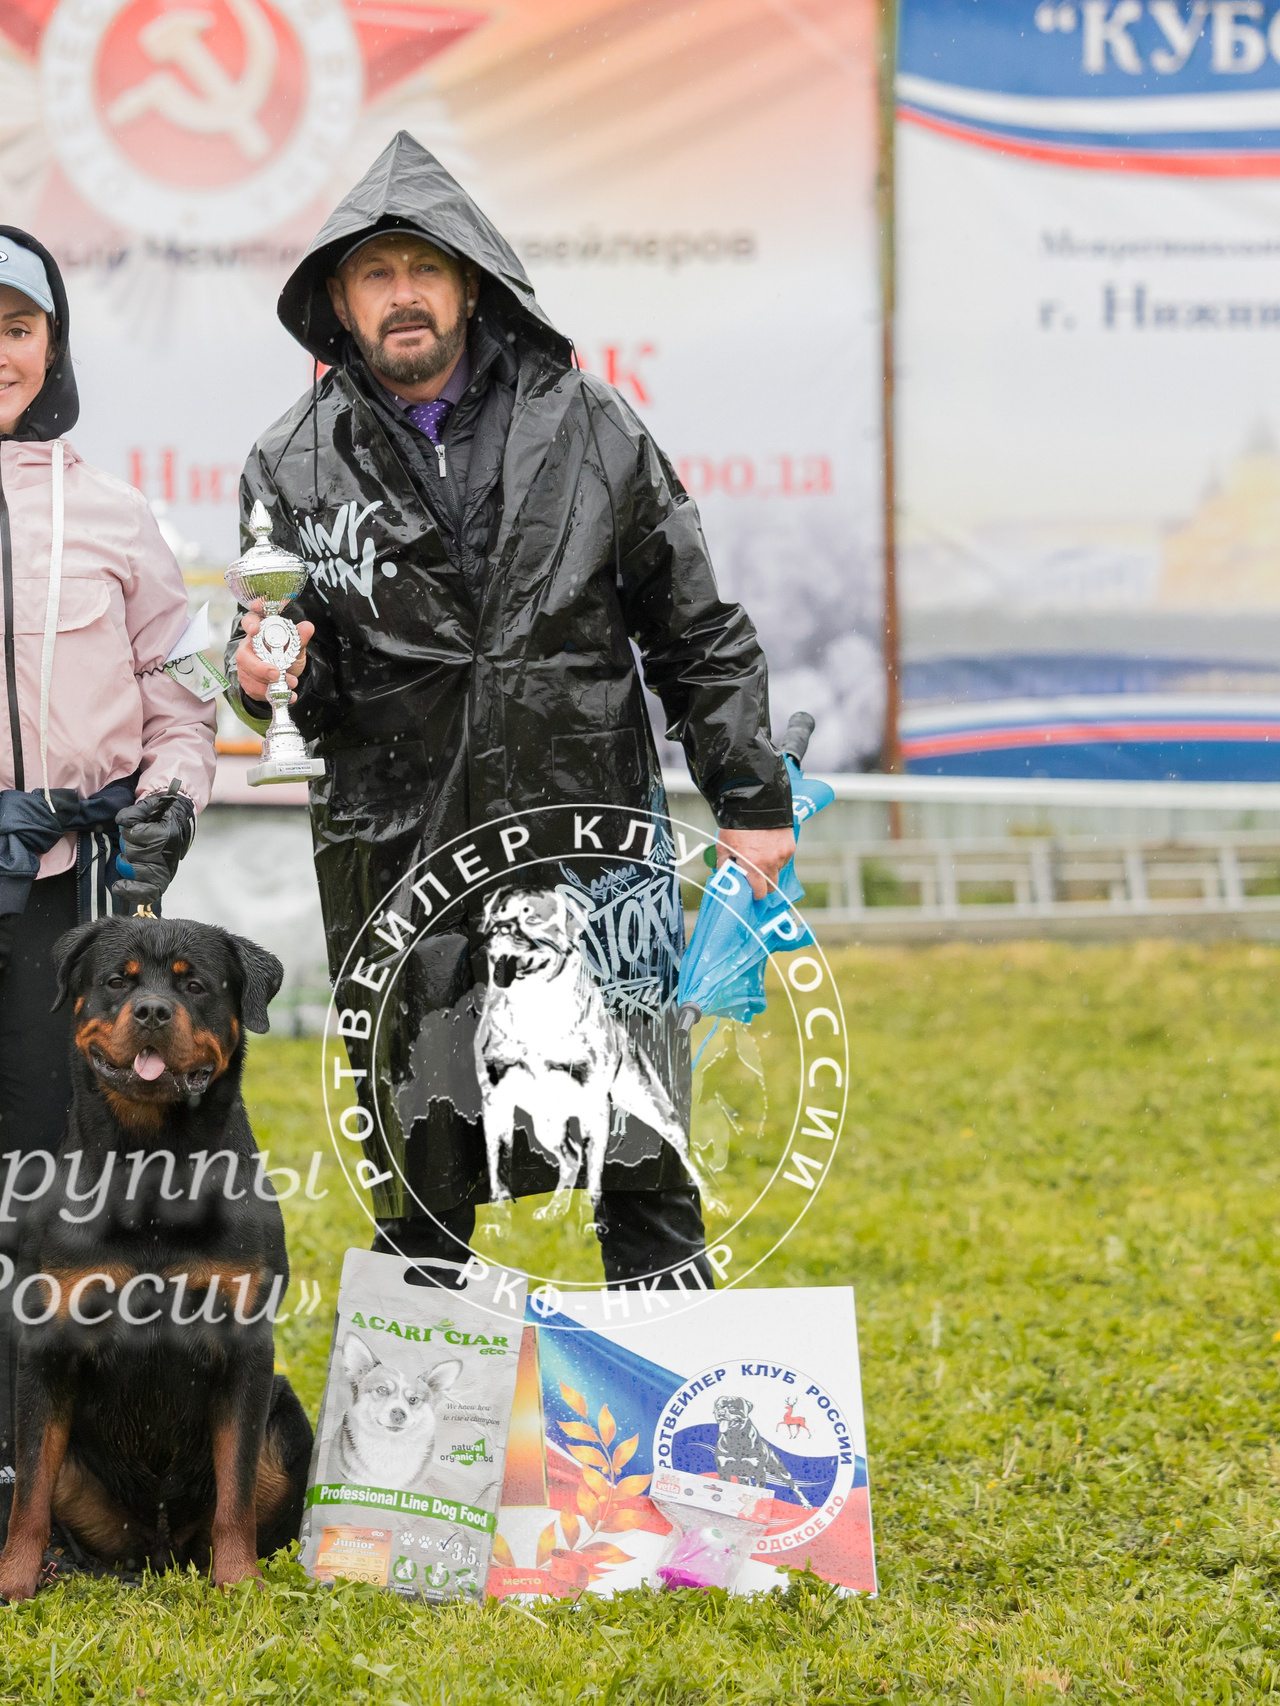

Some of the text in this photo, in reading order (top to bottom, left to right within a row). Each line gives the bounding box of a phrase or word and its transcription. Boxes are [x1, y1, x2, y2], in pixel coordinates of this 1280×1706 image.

[1033, 0, 1280, 76] “КУБ
[351, 1311, 509, 1348] ACARI CIAR
[479, 1347, 507, 1356] eco
[470, 1415, 500, 1425] champion
[658, 1363, 853, 1468] РОТВЕЙЛЕР КЛУБ РОССИИ
[451, 1443, 483, 1452] natural
[439, 1452, 494, 1463] organic food
[320, 1485, 488, 1528] Professional Line Dog Food
[332, 1537, 375, 1550] Junior
